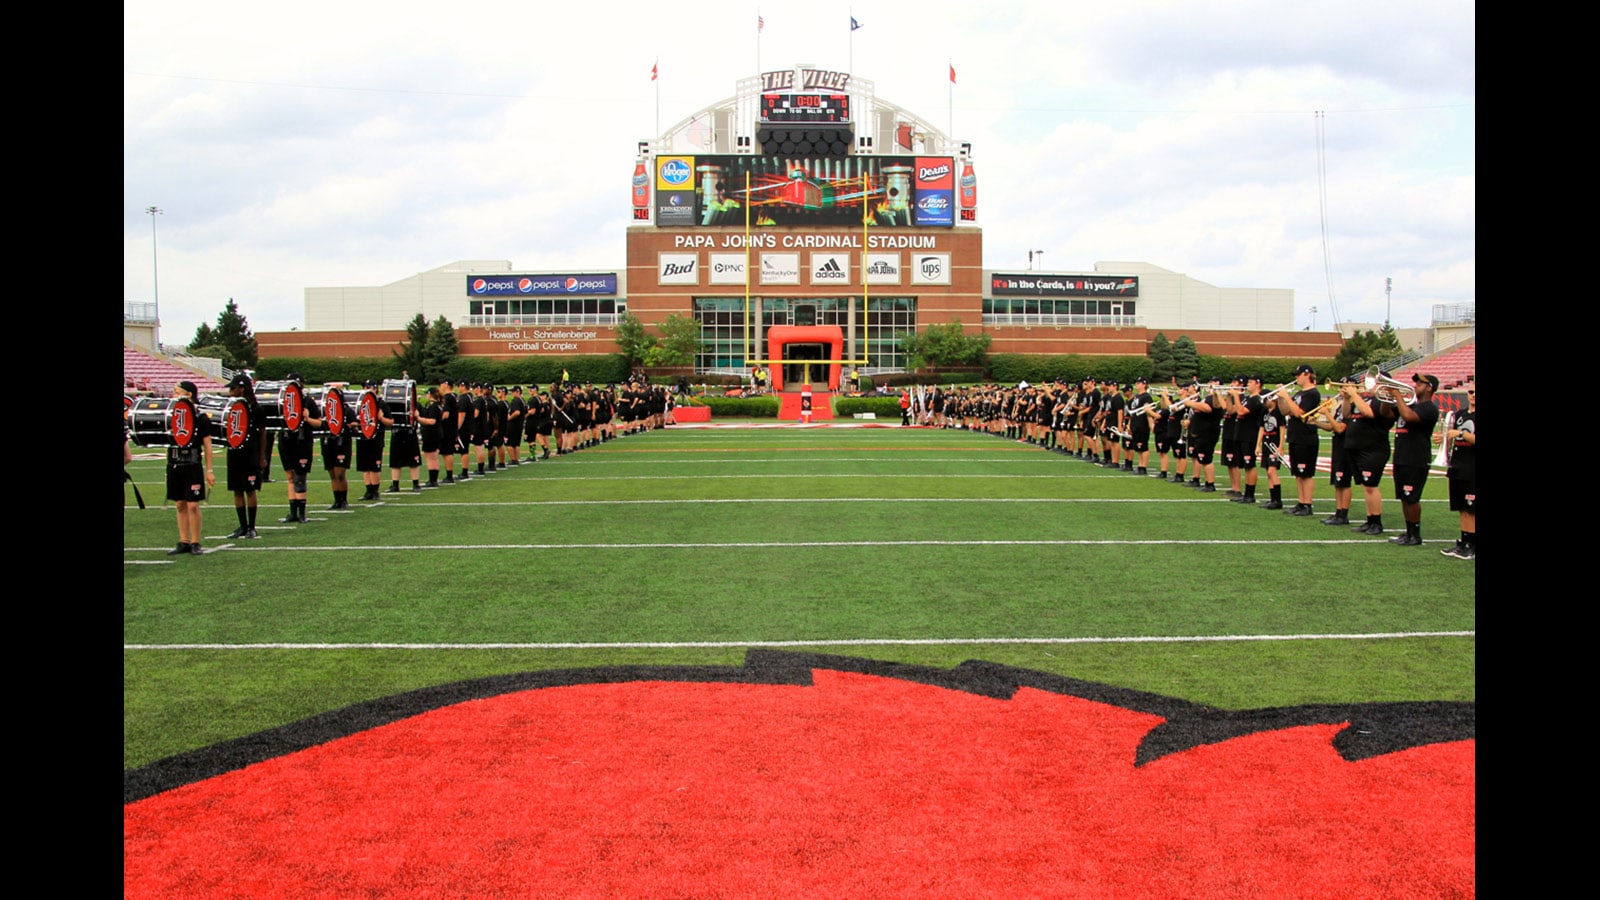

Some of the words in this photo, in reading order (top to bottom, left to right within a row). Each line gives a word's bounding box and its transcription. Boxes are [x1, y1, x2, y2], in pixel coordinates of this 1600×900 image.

[761, 70, 795, 92] THE
[802, 69, 850, 92] VILLE
[797, 96, 820, 106] 0:00
[664, 163, 690, 182] Kroger
[919, 165, 950, 179] Dean's
[634, 209, 648, 219] 40
[961, 210, 975, 220] 40
[675, 235, 715, 248] PAPA
[721, 233, 776, 248] JOHN'S
[782, 235, 862, 248] CARDINAL
[868, 235, 936, 248] STADIUM
[662, 260, 695, 276] Bud
[724, 264, 744, 273] PNC
[866, 265, 879, 275] APA
[922, 264, 940, 277] ups
[815, 271, 846, 279] adidas
[487, 281, 514, 291] pepsi
[533, 280, 560, 291] pepsi
[579, 279, 607, 290] pepsi
[1019, 280, 1035, 289] the
[1036, 280, 1065, 291] Cards,
[1066, 280, 1075, 289] is
[1094, 281, 1116, 292] you?
[489, 331, 520, 339] Howard
[533, 330, 597, 341] Schnellenberger
[508, 342, 540, 351] Football
[542, 341, 578, 352] Complex
